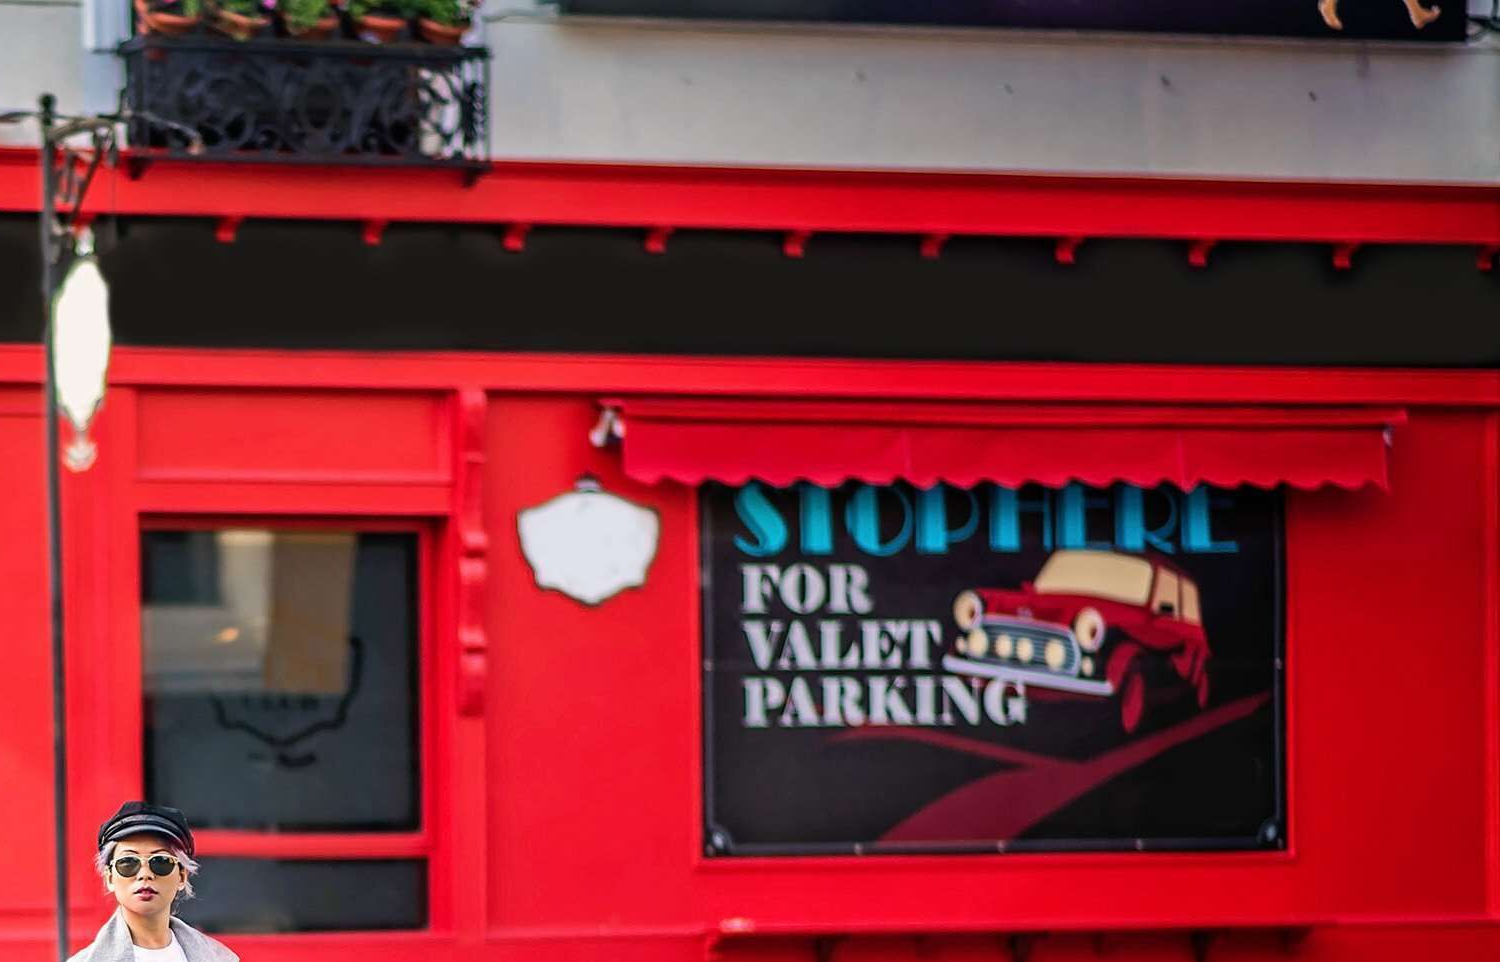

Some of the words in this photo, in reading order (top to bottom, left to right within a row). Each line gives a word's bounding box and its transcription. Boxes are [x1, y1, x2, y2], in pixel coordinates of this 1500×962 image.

[741, 563, 873, 615] FOR
[741, 619, 942, 670] VALET
[742, 675, 1027, 728] PARKING
